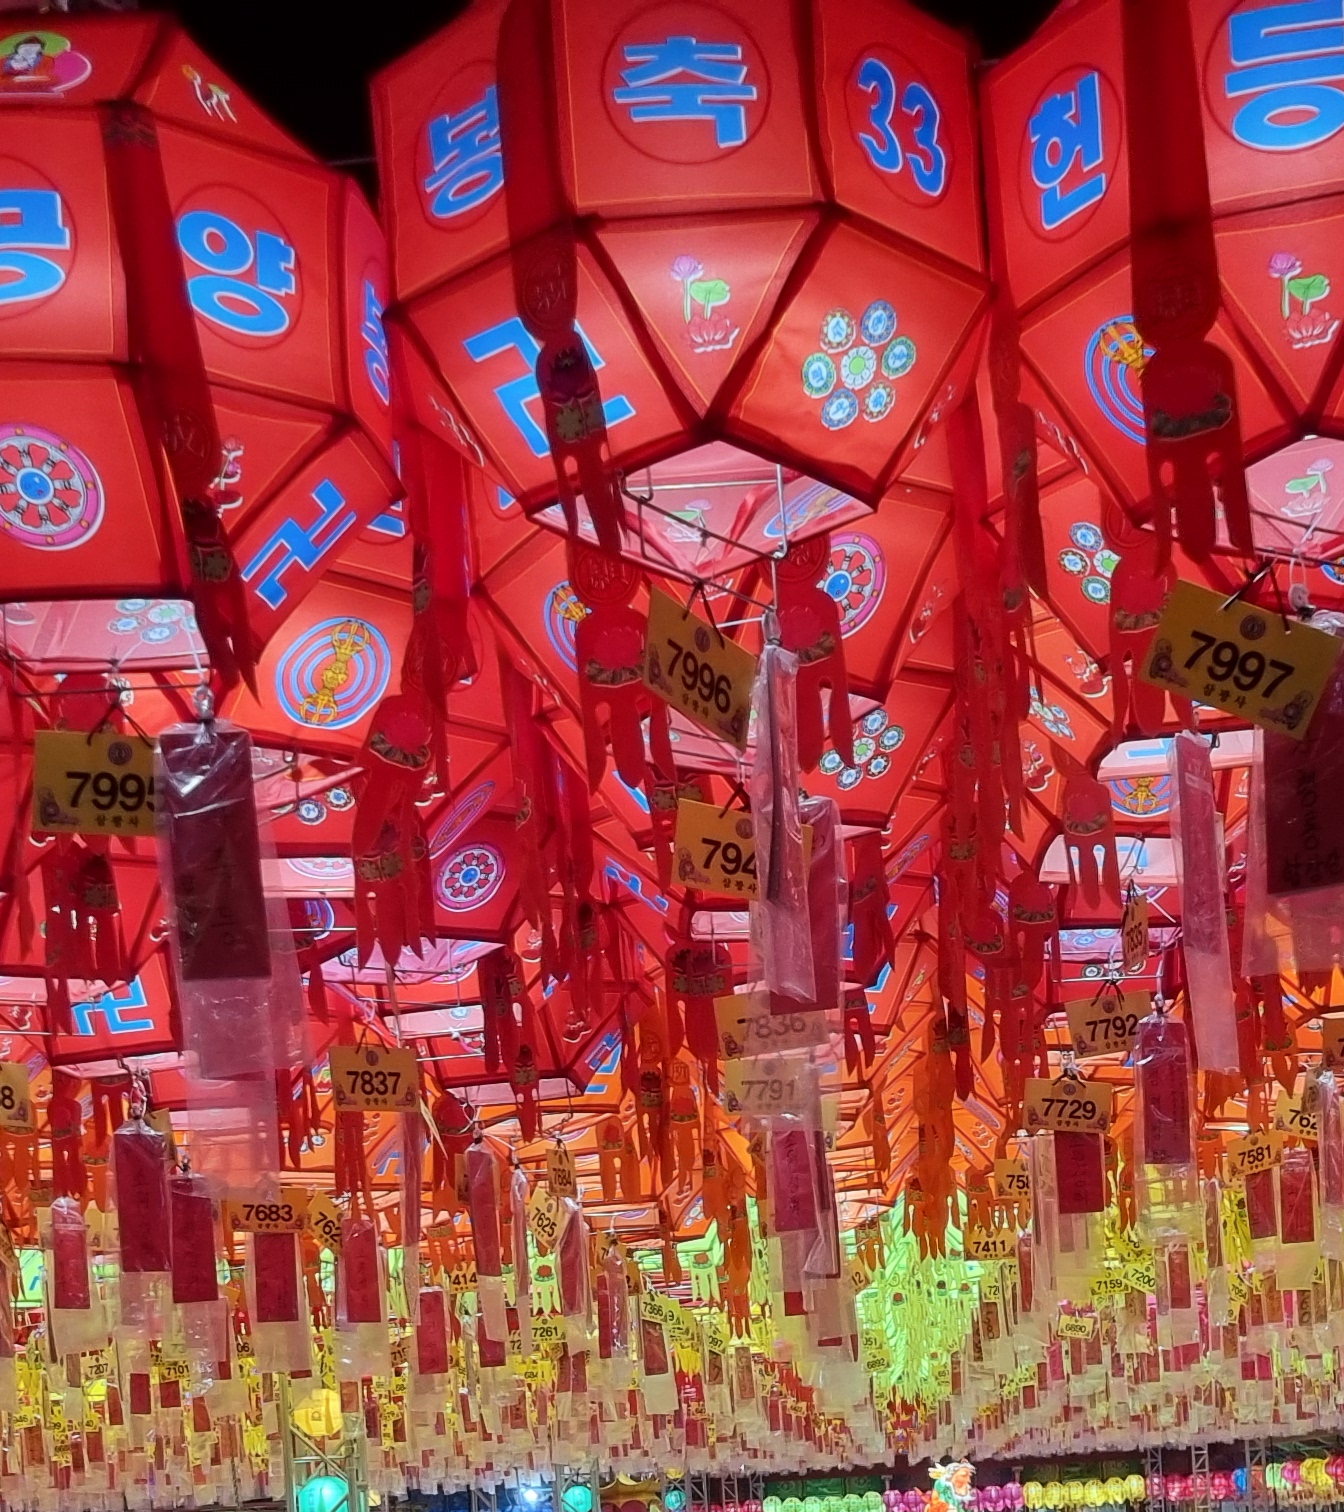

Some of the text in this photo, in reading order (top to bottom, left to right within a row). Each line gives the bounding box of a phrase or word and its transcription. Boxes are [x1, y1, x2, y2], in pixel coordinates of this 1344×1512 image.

[613, 36, 757, 149] 축
[856, 57, 947, 197] 33
[424, 85, 506, 220] 봉
[1028, 70, 1107, 231] 현
[175, 210, 296, 337] 양
[1182, 631, 1295, 695] 7997
[666, 638, 733, 714] 7996
[700, 836, 757, 877] 794
[1086, 1015, 1137, 1041] 7792
[346, 1070, 402, 1096] 7837
[739, 1079, 796, 1107] 7791
[1042, 1098, 1097, 1123] 7729
[1238, 1146, 1273, 1169] 7581
[553, 1169, 572, 1188] 7684
[242, 1203, 294, 1223] 7683
[531, 1211, 558, 1240] 7625
[973, 1241, 1007, 1254] 7411
[1096, 1278, 1123, 1291] 7159
[1131, 1269, 1155, 1289] 7200
[644, 1299, 665, 1320] 7366
[531, 1324, 561, 1338] 7261
[1064, 1322, 1089, 1334] 6890
[87, 1363, 109, 1377] 7207
[165, 1367, 191, 1381] 7101
